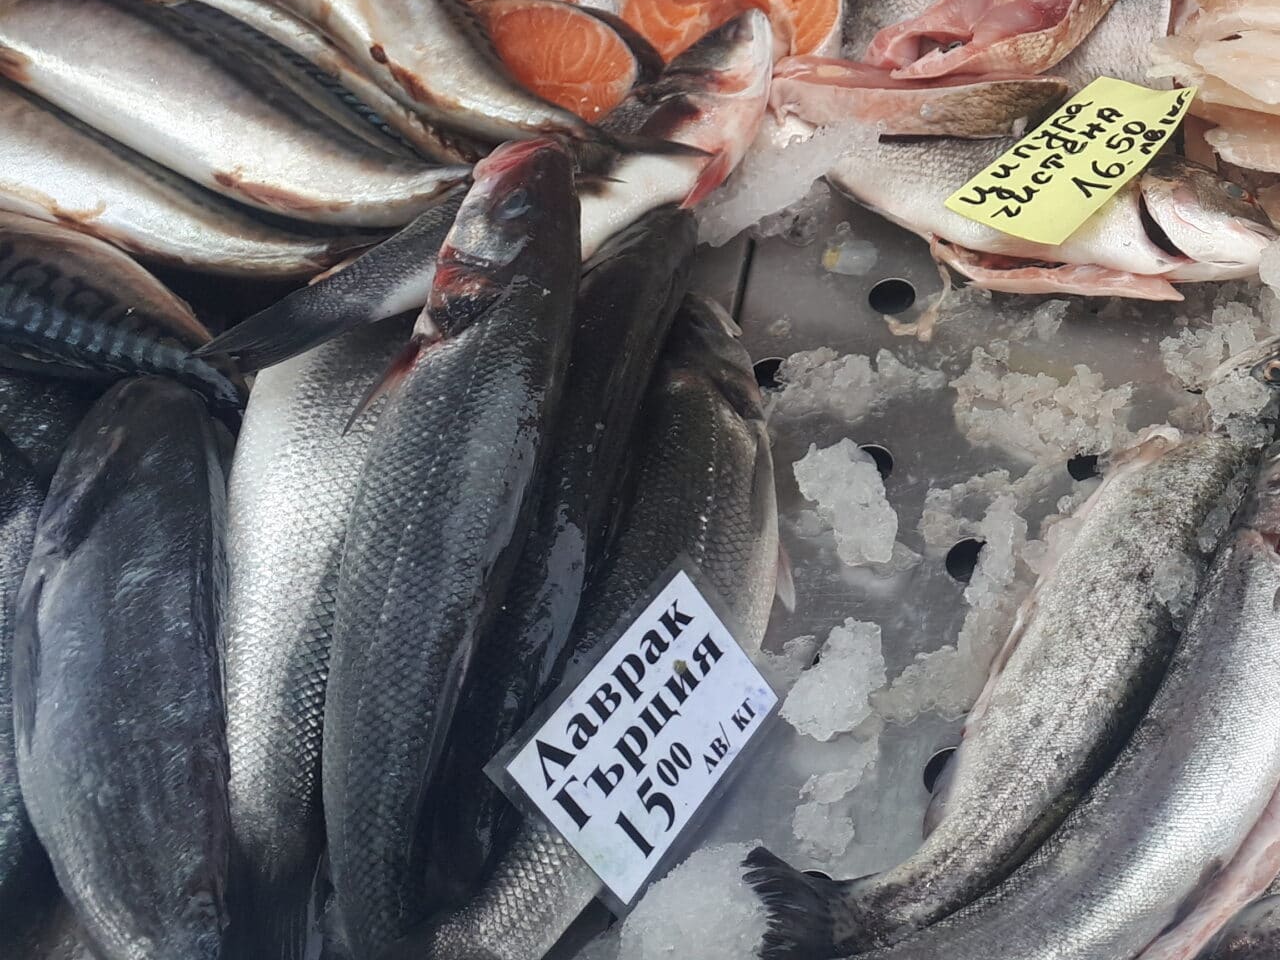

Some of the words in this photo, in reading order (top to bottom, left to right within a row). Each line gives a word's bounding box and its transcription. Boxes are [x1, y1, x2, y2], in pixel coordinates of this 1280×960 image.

[535, 598, 696, 791] Лаврак
[552, 632, 725, 833] Гърция
[730, 697, 757, 733] кг
